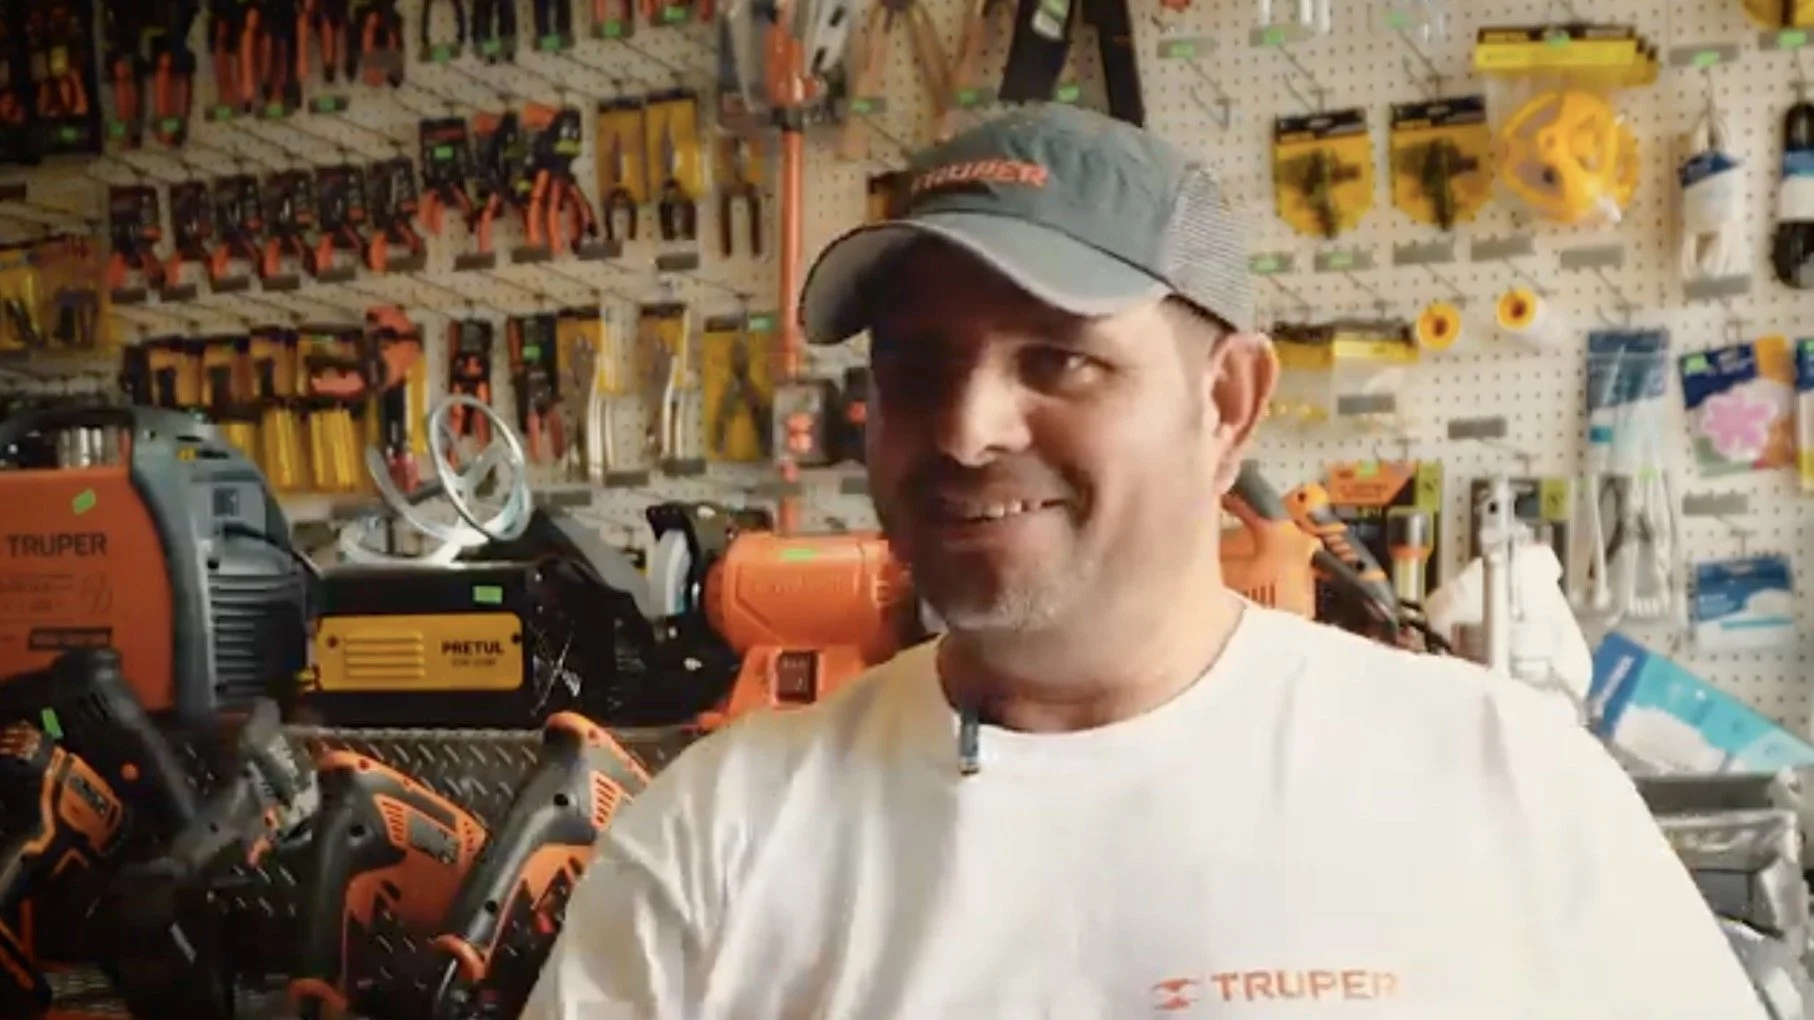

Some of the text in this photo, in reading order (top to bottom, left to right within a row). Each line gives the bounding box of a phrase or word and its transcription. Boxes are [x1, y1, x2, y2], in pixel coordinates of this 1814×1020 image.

[6, 532, 107, 557] TRUPER
[441, 640, 505, 656] PRETUL
[1211, 970, 1397, 1002] TRUPER
